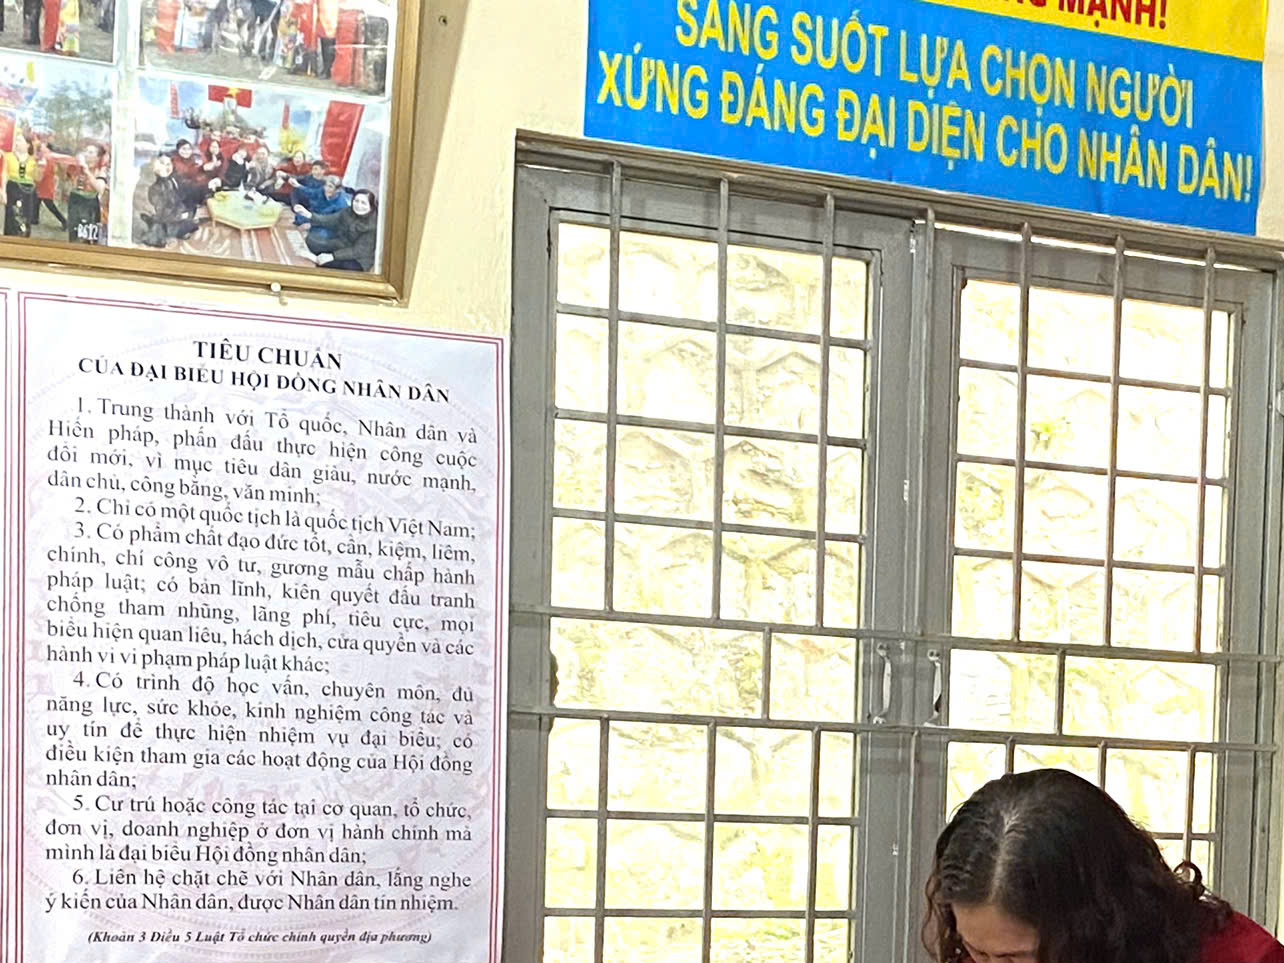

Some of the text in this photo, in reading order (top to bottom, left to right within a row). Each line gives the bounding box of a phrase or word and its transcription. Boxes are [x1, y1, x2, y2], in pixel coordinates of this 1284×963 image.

[790, 9, 889, 77] SUỐT
[899, 31, 972, 99] LỰA
[980, 45, 1076, 117] CHỌN
[1086, 63, 1194, 129] NGƯỜI
[597, 42, 1254, 203] XỨNG ĐÁNG ĐẠI DIỆN CHO NHÂN DÂN!
[192, 337, 250, 362] TIÊU
[342, 378, 401, 399] NHÂN
[407, 382, 449, 403] DÂN
[96, 397, 154, 422] Trung
[357, 418, 406, 439] Nhân
[415, 423, 447, 441] dân
[224, 457, 258, 476] tiêu
[268, 460, 301, 479] dân
[379, 444, 423, 468] công
[47, 469, 81, 488] dân
[129, 475, 175, 499] công
[232, 483, 265, 500] văn
[153, 550, 198, 574] công
[206, 554, 229, 571] vô
[282, 582, 320, 600] kiên
[430, 591, 475, 609] tranh
[118, 597, 165, 616] tham
[348, 609, 381, 627] tiêu
[138, 627, 183, 645] quan
[97, 646, 114, 663] vi
[119, 647, 136, 664] vi
[321, 680, 385, 702] chuyên
[46, 695, 93, 716] năng
[369, 705, 412, 728] công
[46, 723, 70, 740] uy
[140, 746, 186, 764] tham
[192, 747, 220, 769] gia
[45, 768, 92, 786] nhân
[94, 794, 124, 811] Cư
[211, 796, 256, 819] công
[321, 803, 344, 816] cơ
[121, 819, 179, 837] doanh
[281, 845, 325, 863] nhân
[93, 867, 136, 885] Liên
[290, 869, 338, 887] Nhân
[427, 871, 471, 892] nghe
[140, 892, 192, 910] Nhân
[286, 893, 335, 910] Nhân
[338, 892, 370, 910] dân
